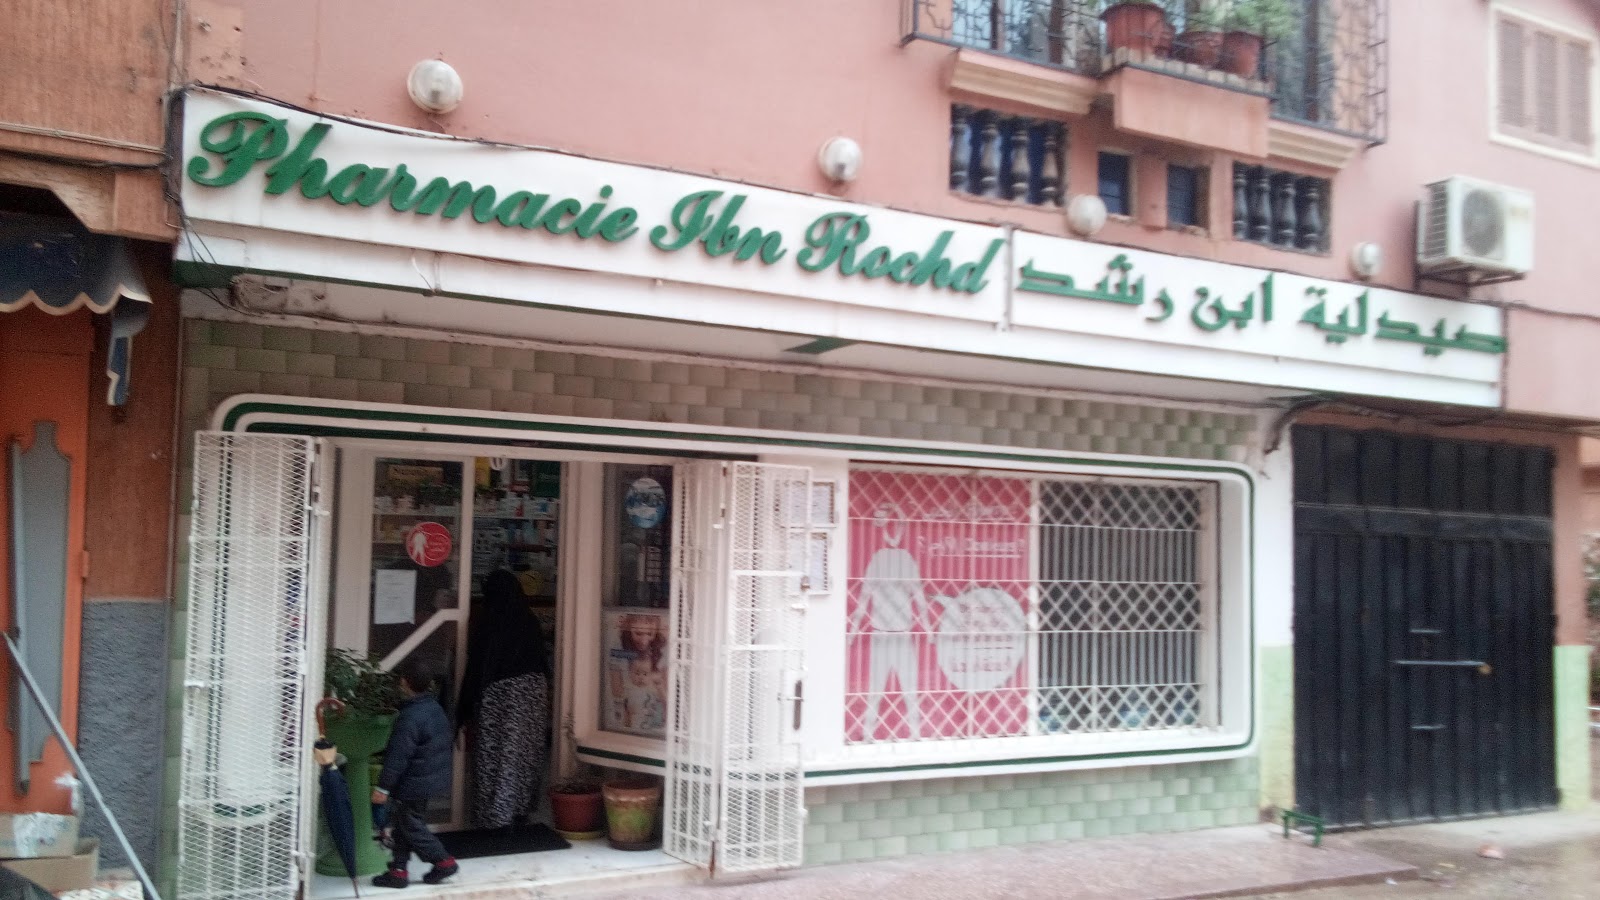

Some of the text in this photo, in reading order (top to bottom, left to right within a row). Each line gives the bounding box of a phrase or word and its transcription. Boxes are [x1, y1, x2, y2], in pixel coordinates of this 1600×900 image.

[187, 110, 1005, 293] Pharmacie Ibn Rochd
[1017, 254, 1506, 356] صيدلية ابن رشد
